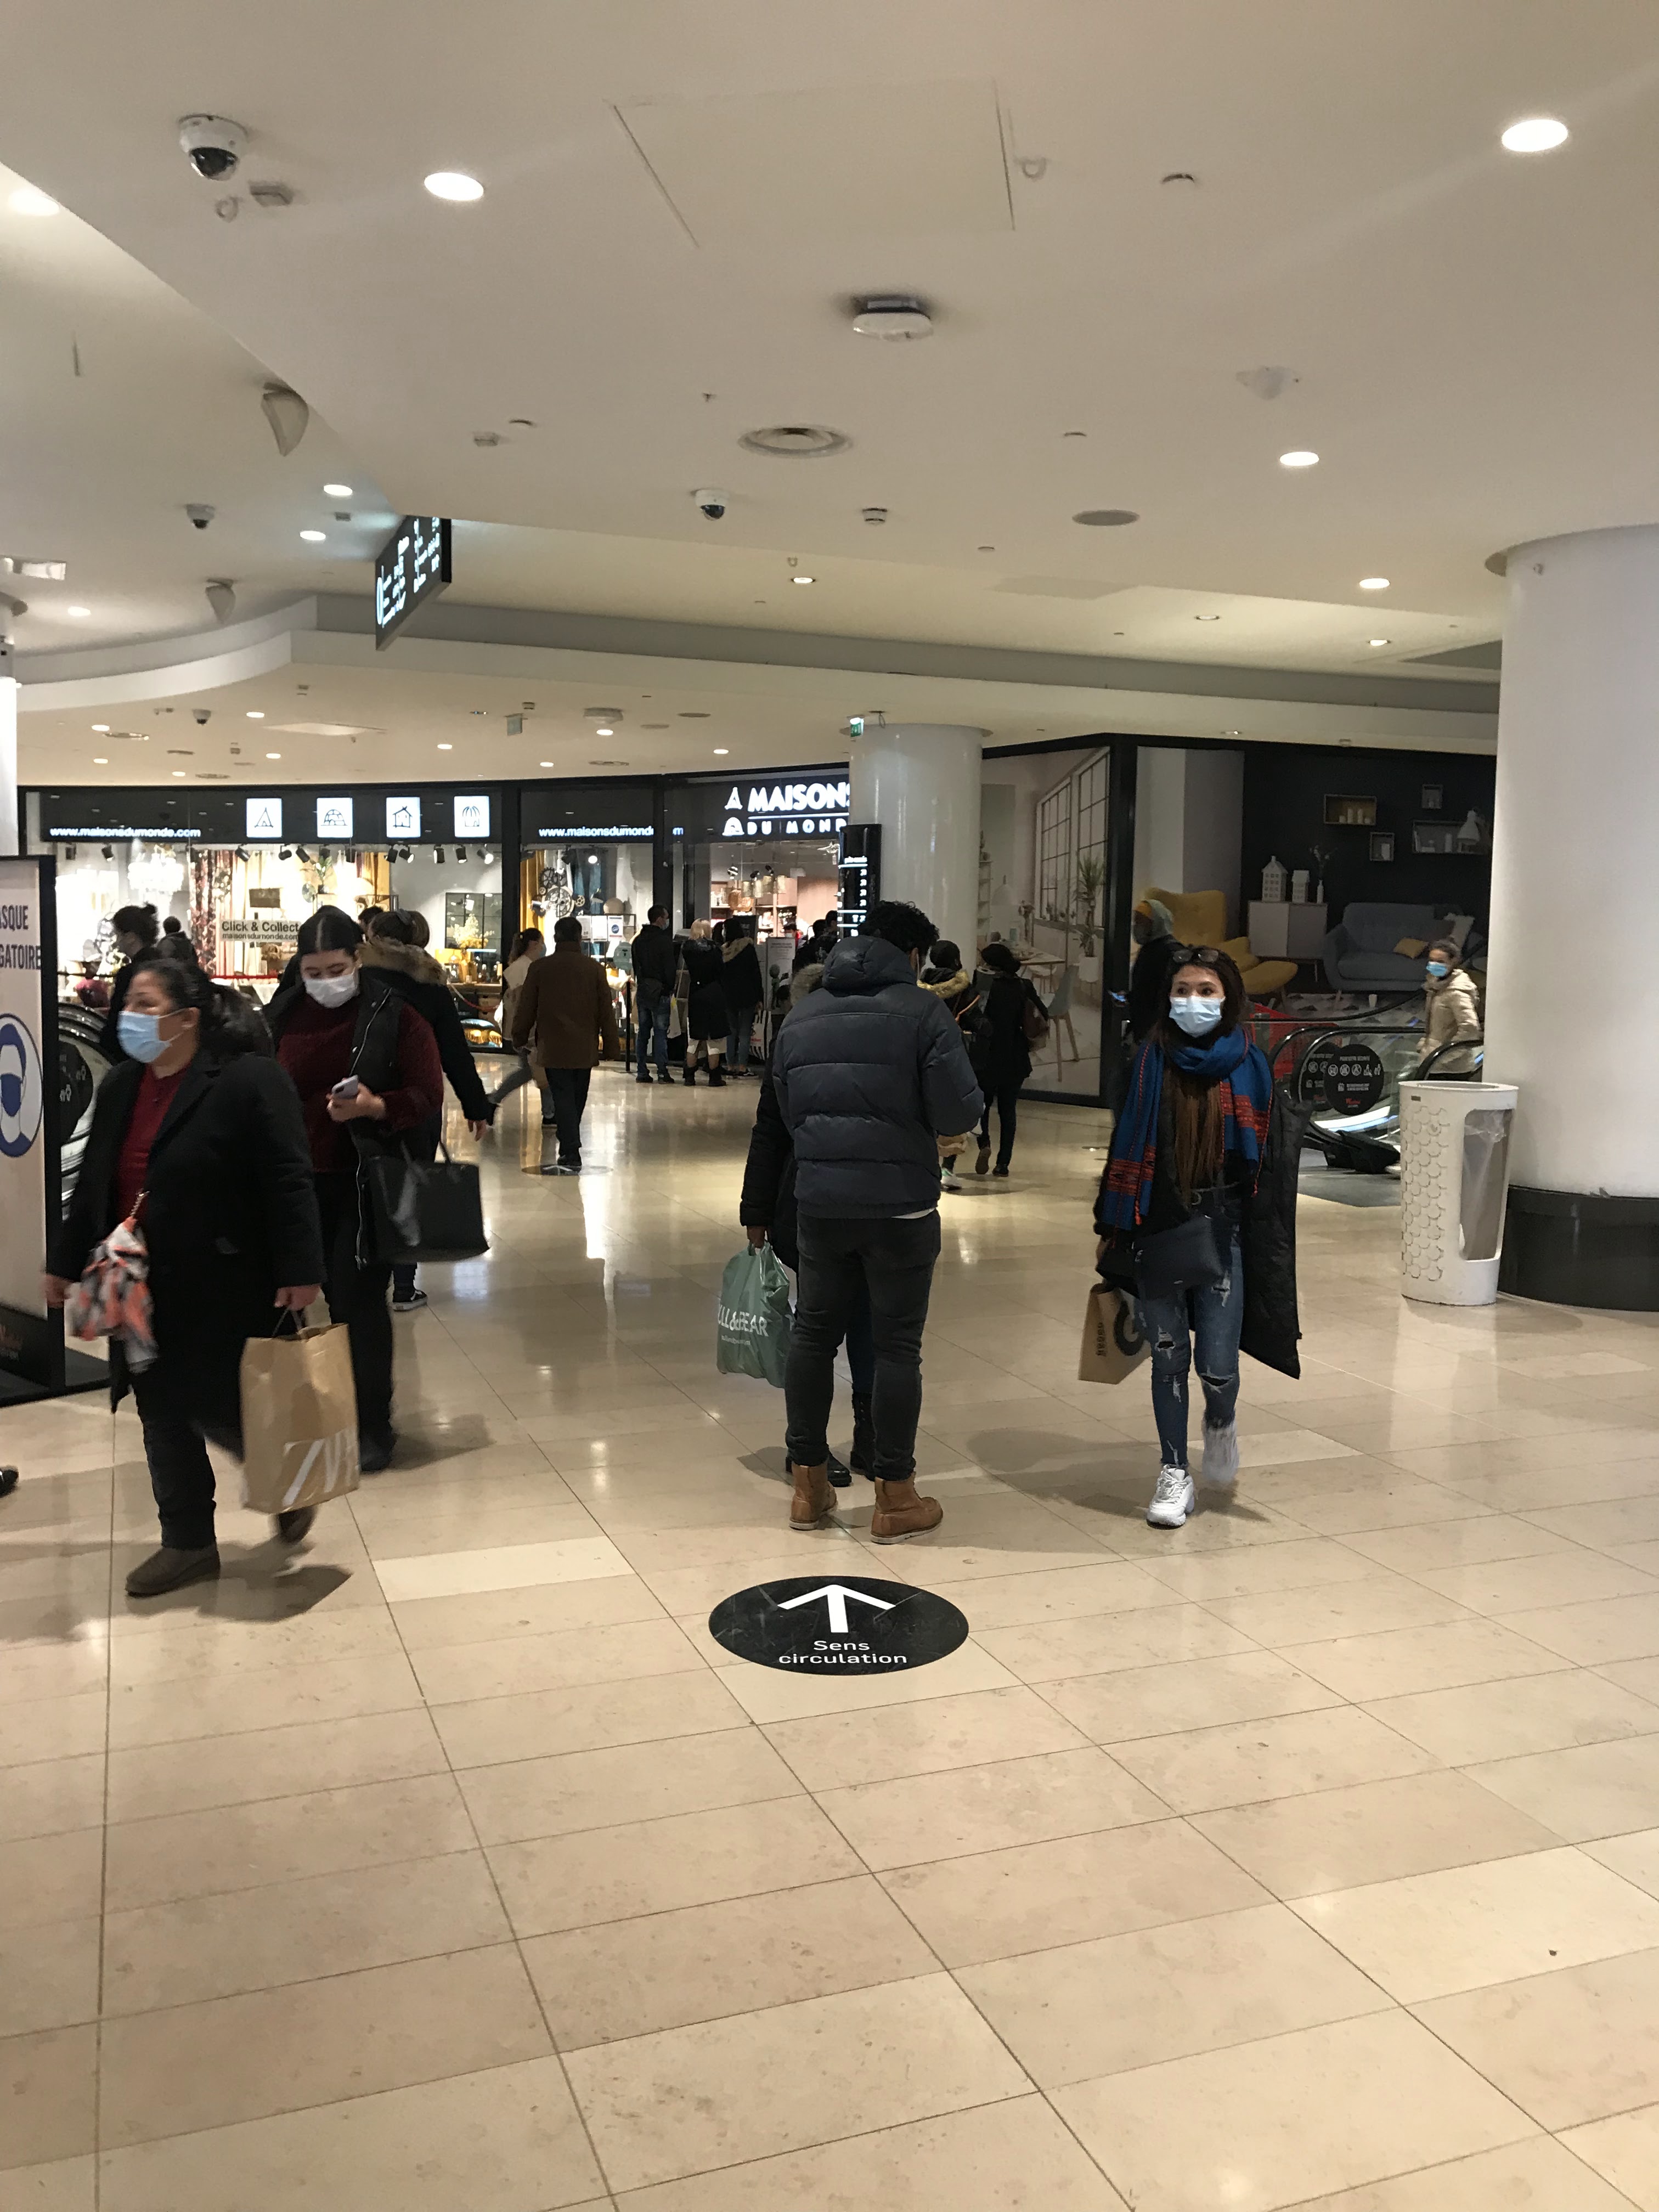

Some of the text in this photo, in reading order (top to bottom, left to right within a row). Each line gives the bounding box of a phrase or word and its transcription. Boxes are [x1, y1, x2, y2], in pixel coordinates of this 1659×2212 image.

[49, 826, 201, 838] www.maisonsdumonde.com
[747, 821, 772, 835] DU
[0, 905, 29, 931] SQUE
[222, 921, 300, 932] Click & Collect
[813, 1640, 870, 1651] Sens
[778, 1653, 907, 1664] circulation
